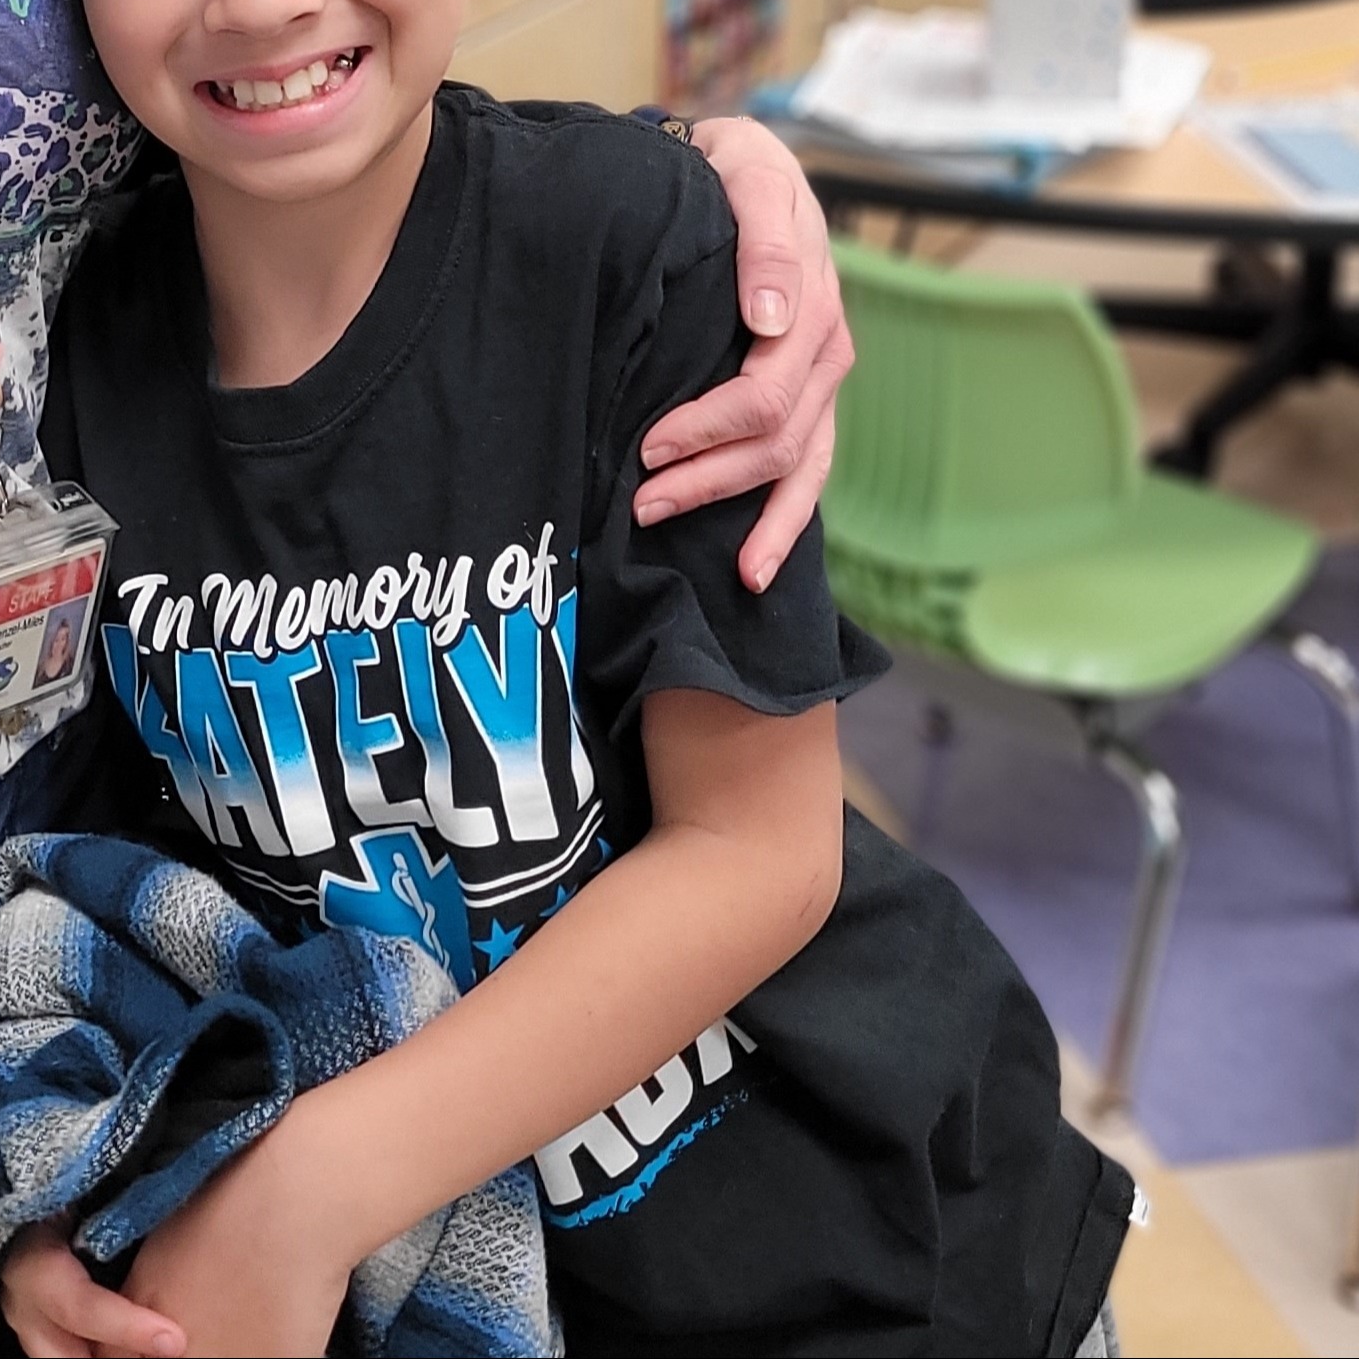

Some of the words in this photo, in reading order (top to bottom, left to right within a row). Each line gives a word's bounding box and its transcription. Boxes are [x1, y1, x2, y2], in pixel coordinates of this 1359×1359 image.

[8, 581, 55, 614] STAFF
[118, 573, 193, 655] In
[202, 551, 474, 658] Memory
[487, 521, 557, 625] of
